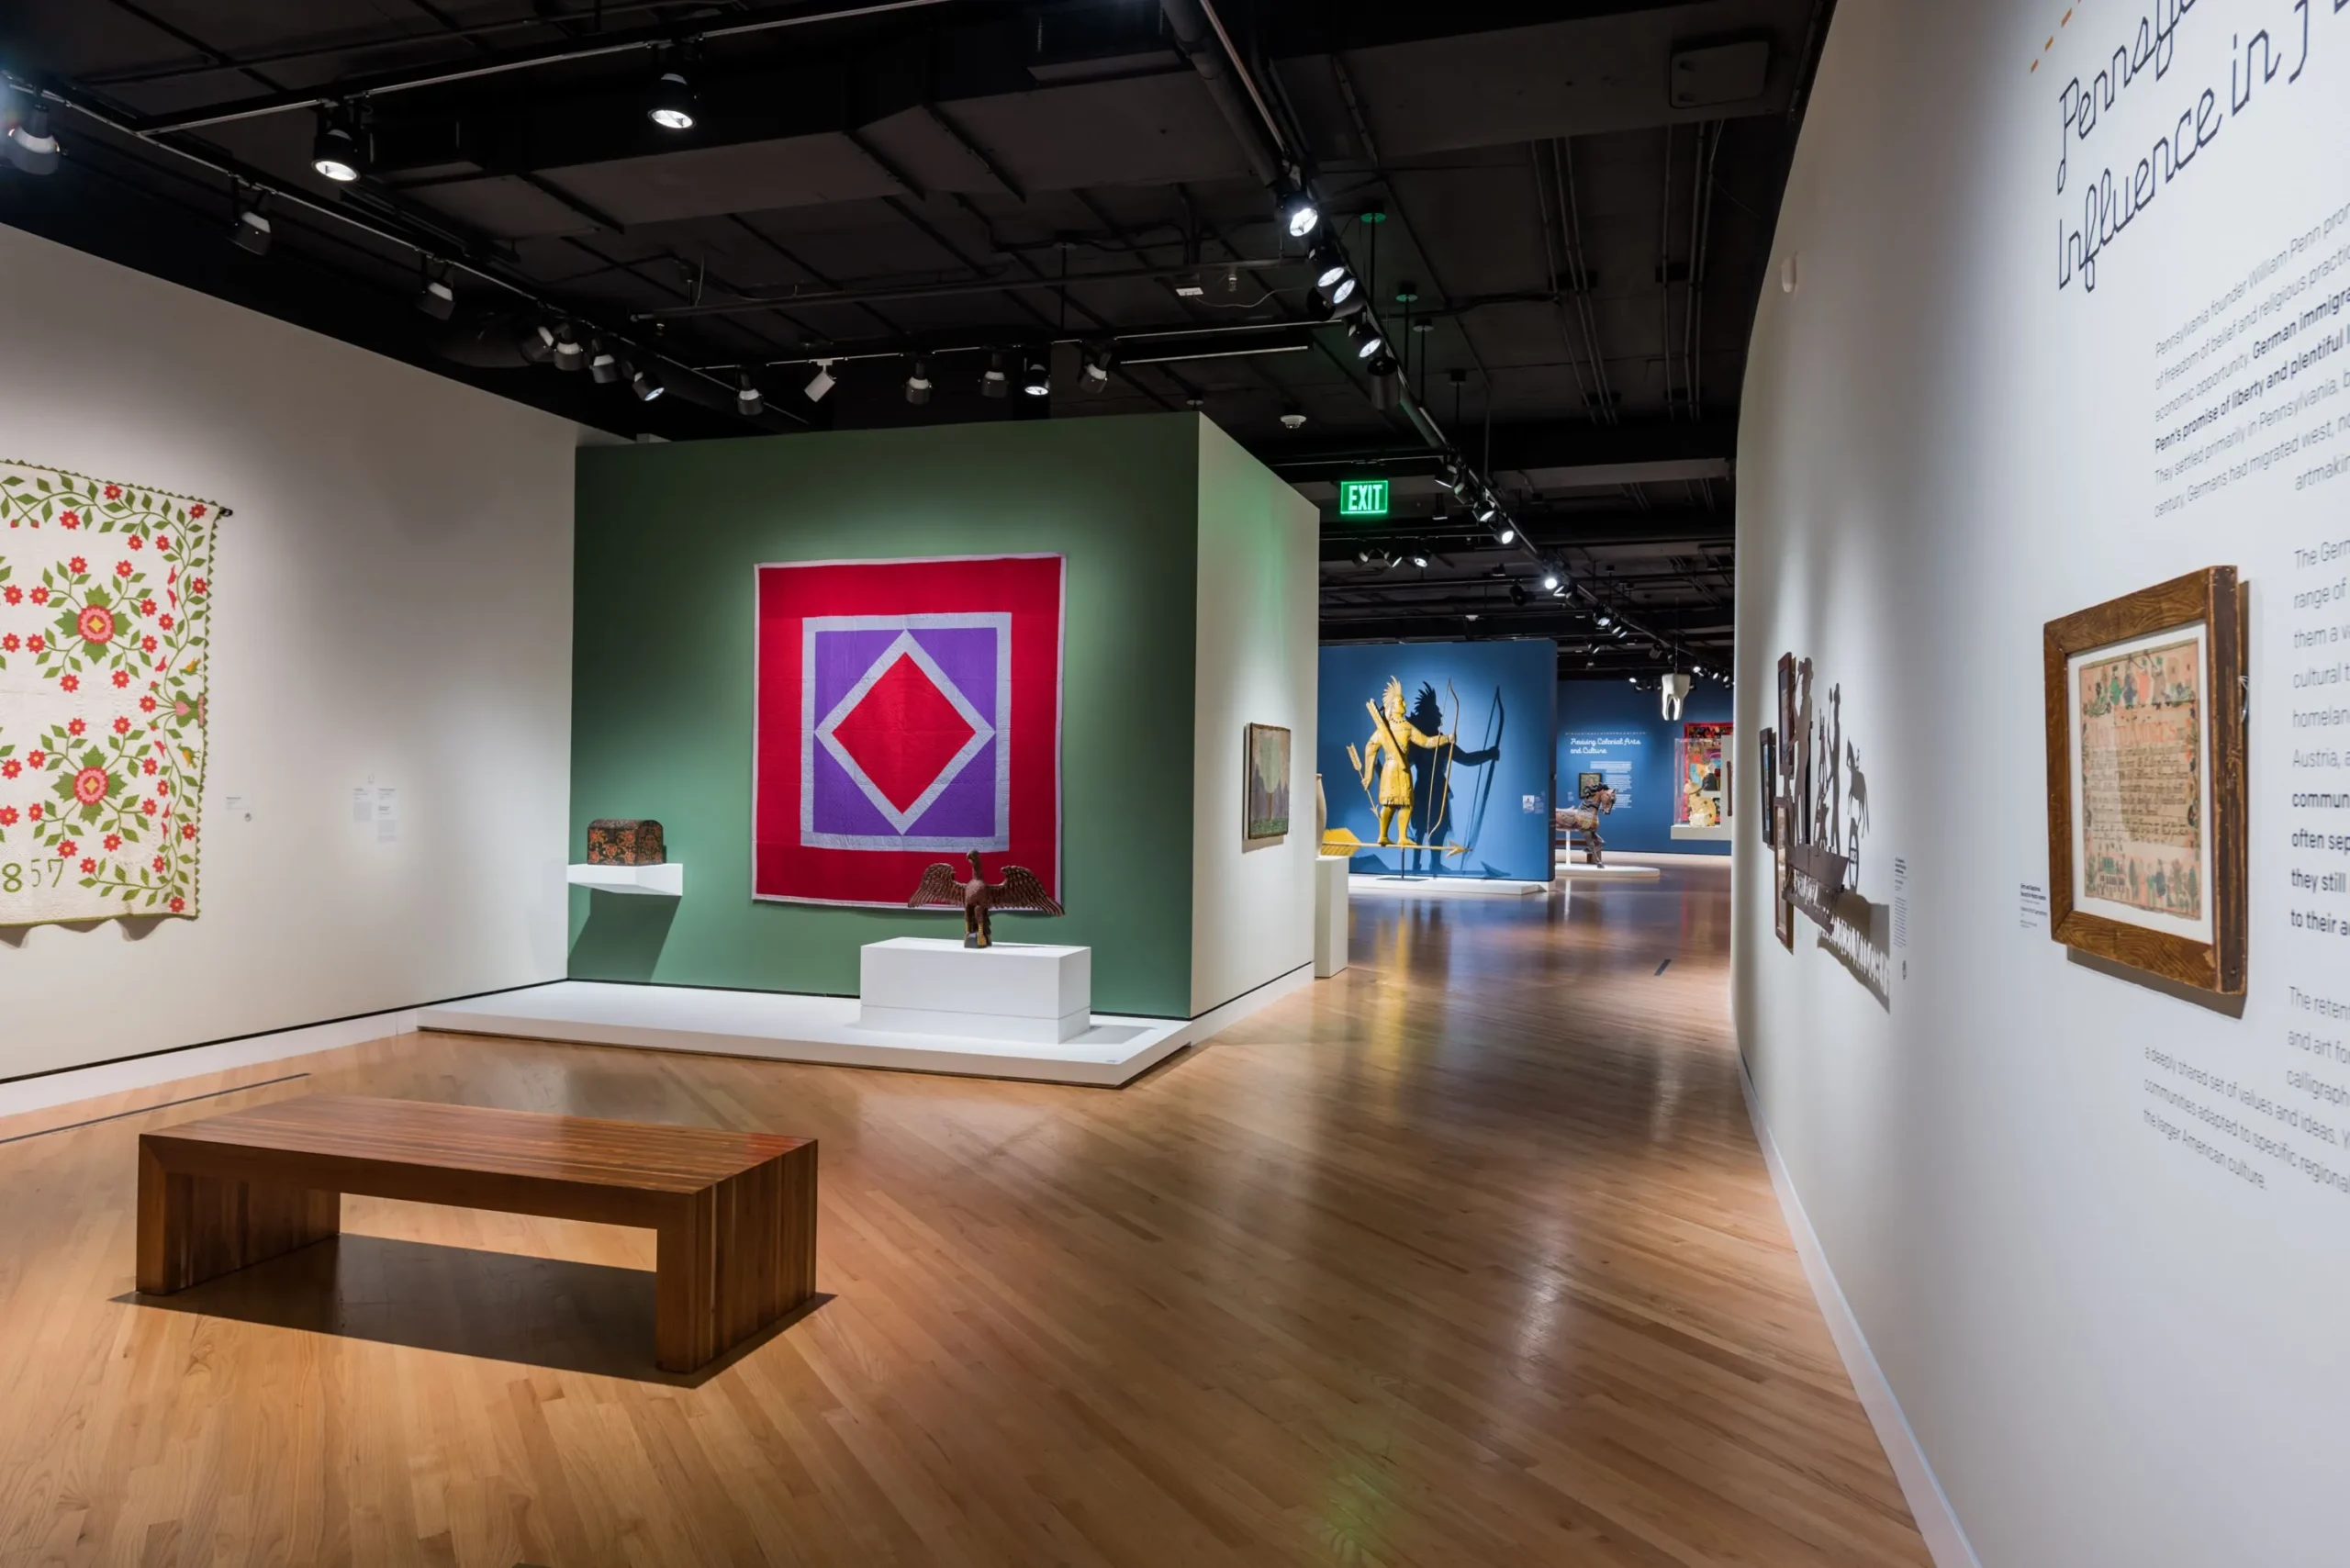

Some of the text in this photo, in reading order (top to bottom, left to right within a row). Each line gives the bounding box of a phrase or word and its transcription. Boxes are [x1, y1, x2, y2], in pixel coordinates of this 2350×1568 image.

[2057, 0, 2197, 196] Pennsy
[2058, 29, 2282, 293] Influence in
[2211, 280, 2247, 319] founder
[2248, 251, 2288, 289] William
[2290, 226, 2320, 259] Penn
[2211, 319, 2237, 353] belief
[2238, 304, 2258, 333] and
[2258, 275, 2307, 320] religious
[2253, 321, 2297, 359] German
[2154, 427, 2182, 454] Penn's
[2183, 407, 2219, 442] promise
[2221, 395, 2231, 416] of
[2232, 378, 2265, 409] liberty
[2266, 359, 2288, 388] and
[2290, 328, 2344, 380] plentiful
[2154, 465, 2174, 487] They
[2175, 444, 2204, 476] settled
[2205, 425, 2246, 464] primarily
[2247, 420, 2258, 437] in
[2188, 471, 2229, 502] Germans
[2229, 457, 2248, 483] had
[2250, 432, 2299, 473] migrated
[2302, 420, 2334, 448] west,
[1348, 484, 1383, 510] EXIT
[2294, 548, 2318, 570] The
[2294, 577, 2346, 610] range of
[2294, 628, 2327, 648] them
[2331, 626, 2339, 642] a
[2294, 661, 2341, 689] cultural
[1597, 737, 1623, 745] Colonial
[1623, 737, 1641, 746] Arts
[2292, 747, 2341, 769] Austria,
[2292, 828, 2324, 849] often
[2291, 868, 2346, 893] they still
[2290, 909, 2303, 928] to
[2305, 911, 2336, 934] their
[2288, 985, 2311, 1011] The
[2288, 1030, 2311, 1051] and
[2313, 1039, 2332, 1059] art
[2178, 1059, 2209, 1086] shared
[2210, 1074, 2224, 1095] set
[2227, 1081, 2238, 1099] of
[2238, 1088, 2273, 1116] values
[2276, 1105, 2298, 1127] and
[2144, 1079, 2196, 1116] communities
[2199, 1104, 2238, 1137] adapted
[2240, 1124, 2251, 1144] to
[2253, 1132, 2298, 1168] specific
[2157, 1114, 2181, 1141] larger
[2182, 1127, 2226, 1169] American
